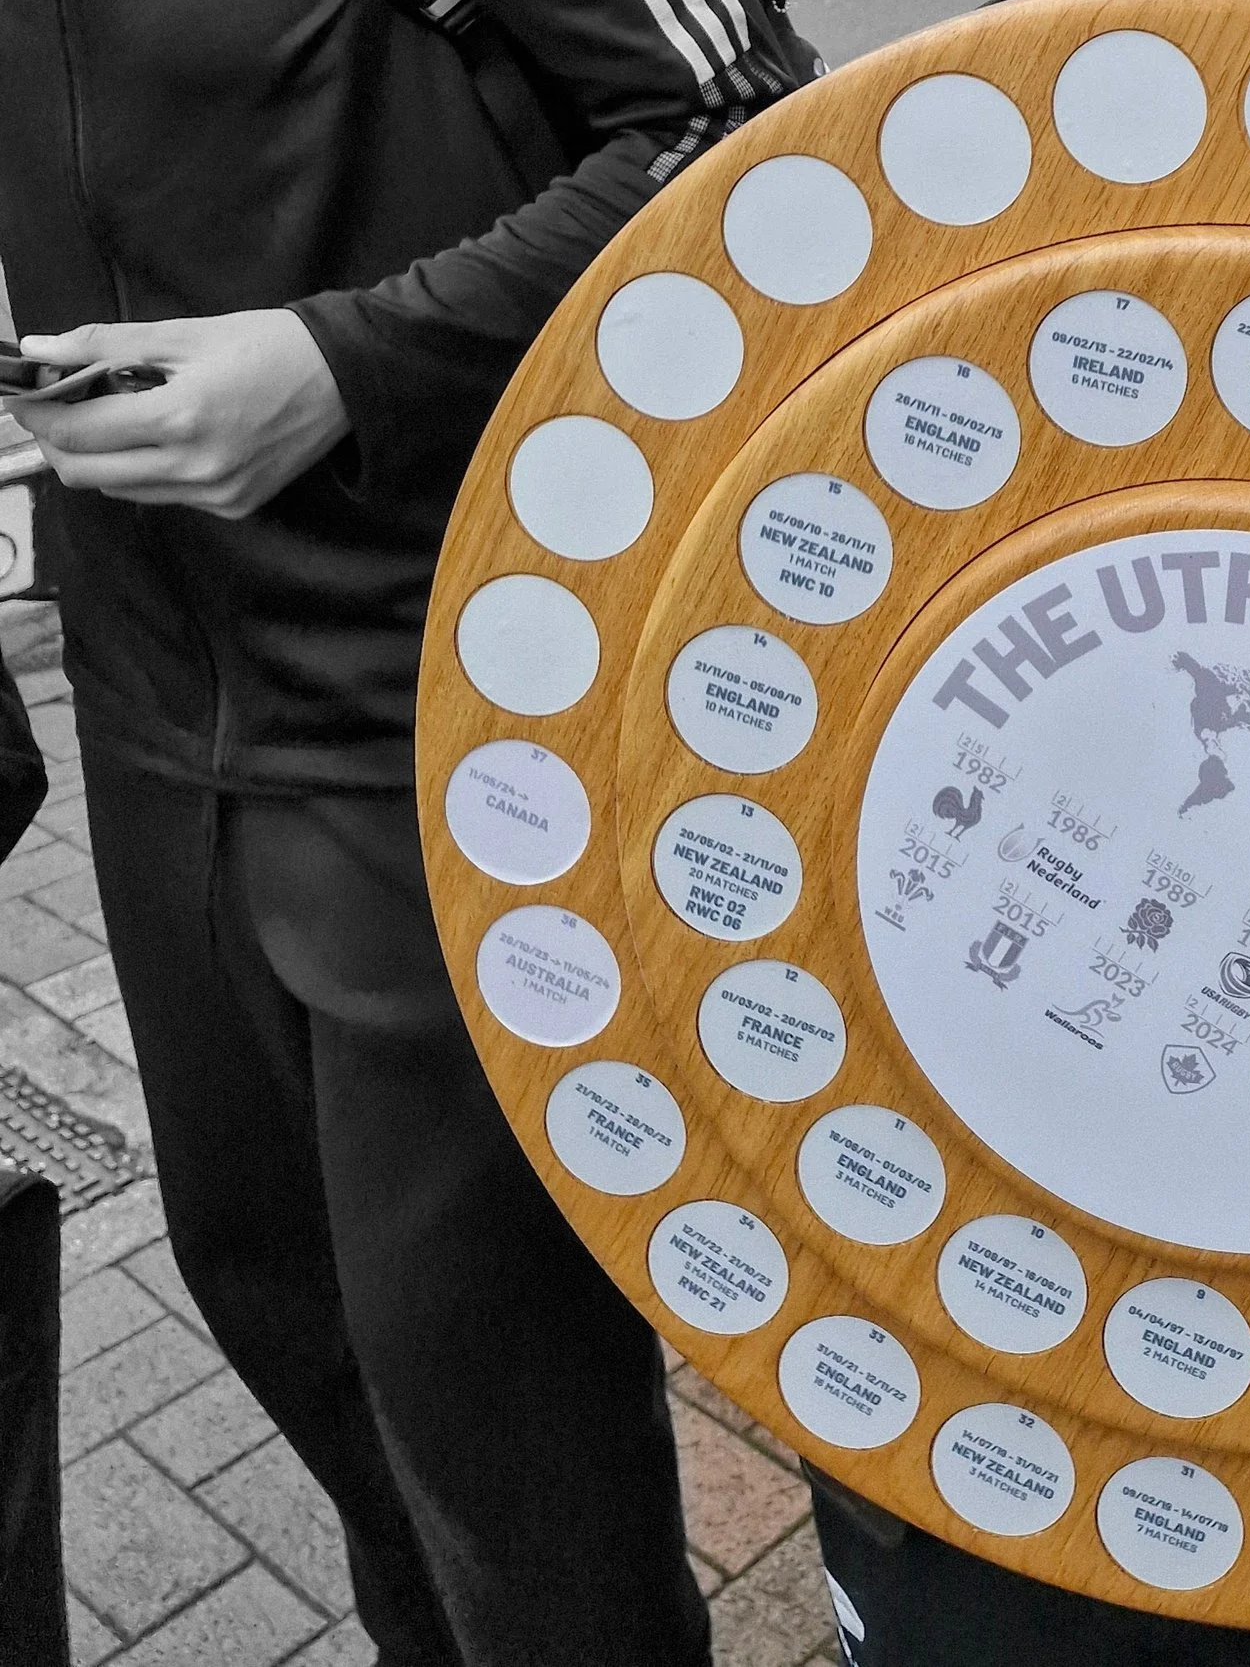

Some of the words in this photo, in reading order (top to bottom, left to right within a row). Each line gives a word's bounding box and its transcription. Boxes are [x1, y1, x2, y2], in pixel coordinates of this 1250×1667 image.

[1116, 297, 1131, 311] 17
[1051, 331, 1108, 354] 09/02/13
[1116, 347, 1174, 371] 22/02/14
[1072, 354, 1145, 384] IRELAND
[956, 364, 971, 379] 16
[904, 414, 982, 453] ENGLAND
[828, 481, 842, 495] 15
[759, 524, 798, 548] NEW
[797, 538, 874, 575] ZEALAND
[778, 568, 816, 592] RWC
[818, 582, 835, 598] 10
[753, 633, 768, 648] 14
[932, 584, 1103, 729] THE
[705, 682, 780, 719] ENGLAND
[530, 749, 548, 763] 37
[952, 751, 1008, 794] 1982
[485, 794, 549, 833] CANADA
[740, 803, 755, 818] 13
[1047, 810, 1099, 852] 1986
[672, 842, 710, 866] NEW
[709, 857, 784, 896] ZEALAND
[899, 837, 955, 880] 2015
[1036, 847, 1084, 882] Rugby
[689, 884, 725, 908] RWC
[726, 900, 747, 918] 02
[1026, 859, 1101, 910] Nederland
[1141, 869, 1198, 909] 1989
[684, 899, 721, 922] RWC
[722, 914, 742, 931] 06
[993, 896, 1049, 937] 2015
[504, 953, 590, 1002] AUSTRALIA
[785, 968, 799, 983] 12
[1089, 955, 1146, 998] 2023
[741, 1015, 804, 1050] FRANCE
[1044, 1009, 1104, 1051] Wallaroos
[1180, 1013, 1238, 1056] 2024
[634, 1073, 650, 1089] 35
[586, 1108, 645, 1150] FRANCE
[894, 1119, 906, 1132] 11
[836, 1152, 908, 1199] ENGLAND
[738, 1214, 755, 1231] 34
[1030, 1226, 1045, 1240] 10
[669, 1234, 703, 1261] NEW
[700, 1255, 766, 1303] ZEALAND
[957, 1254, 996, 1279] NEW
[993, 1272, 1066, 1316] ZEALAND
[677, 1275, 710, 1302] RWC
[708, 1296, 727, 1313] 21
[868, 1328, 886, 1344] 33
[1141, 1328, 1216, 1369] ENGLAND
[815, 1360, 882, 1406] ENGLAND
[1018, 1413, 1036, 1429] 32
[951, 1441, 987, 1466] NEW
[985, 1458, 1055, 1500] ZEALAND
[1180, 1465, 1196, 1479] 31
[1134, 1506, 1206, 1542] ENGLAND
